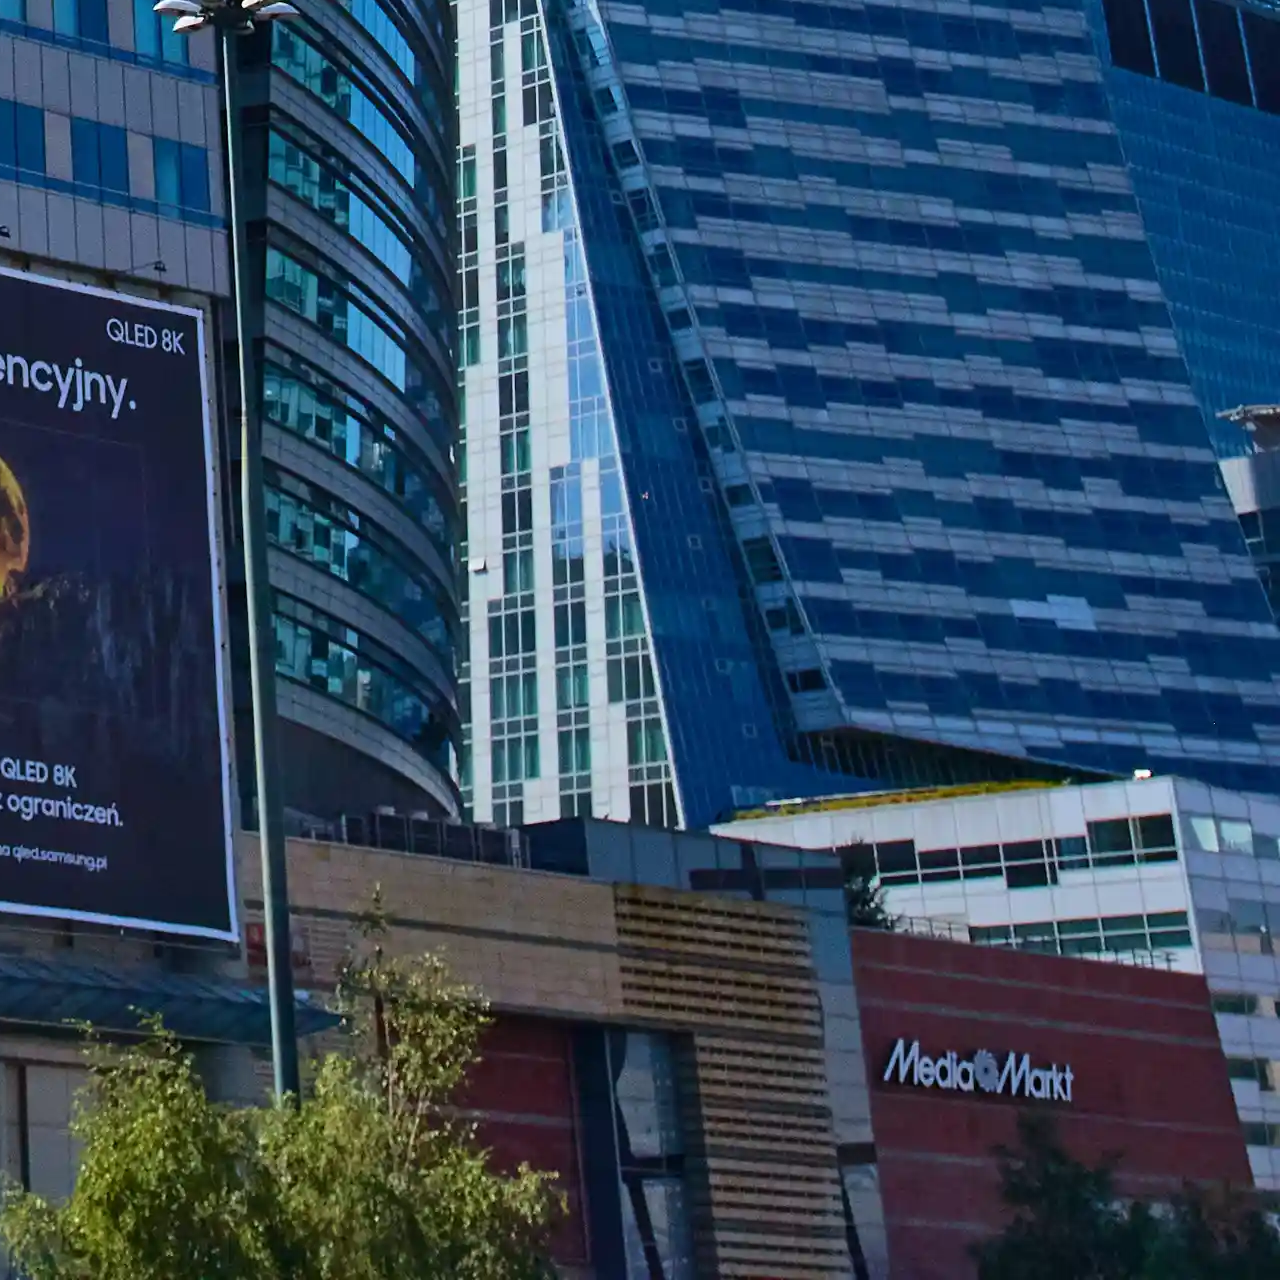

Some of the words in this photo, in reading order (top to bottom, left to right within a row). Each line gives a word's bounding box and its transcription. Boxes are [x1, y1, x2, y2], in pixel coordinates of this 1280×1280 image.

[106, 317, 158, 349] QLED
[161, 328, 186, 356] 8K
[0, 757, 49, 783] QLED
[52, 763, 78, 788] 8K
[7, 796, 124, 827] ograniczeń.
